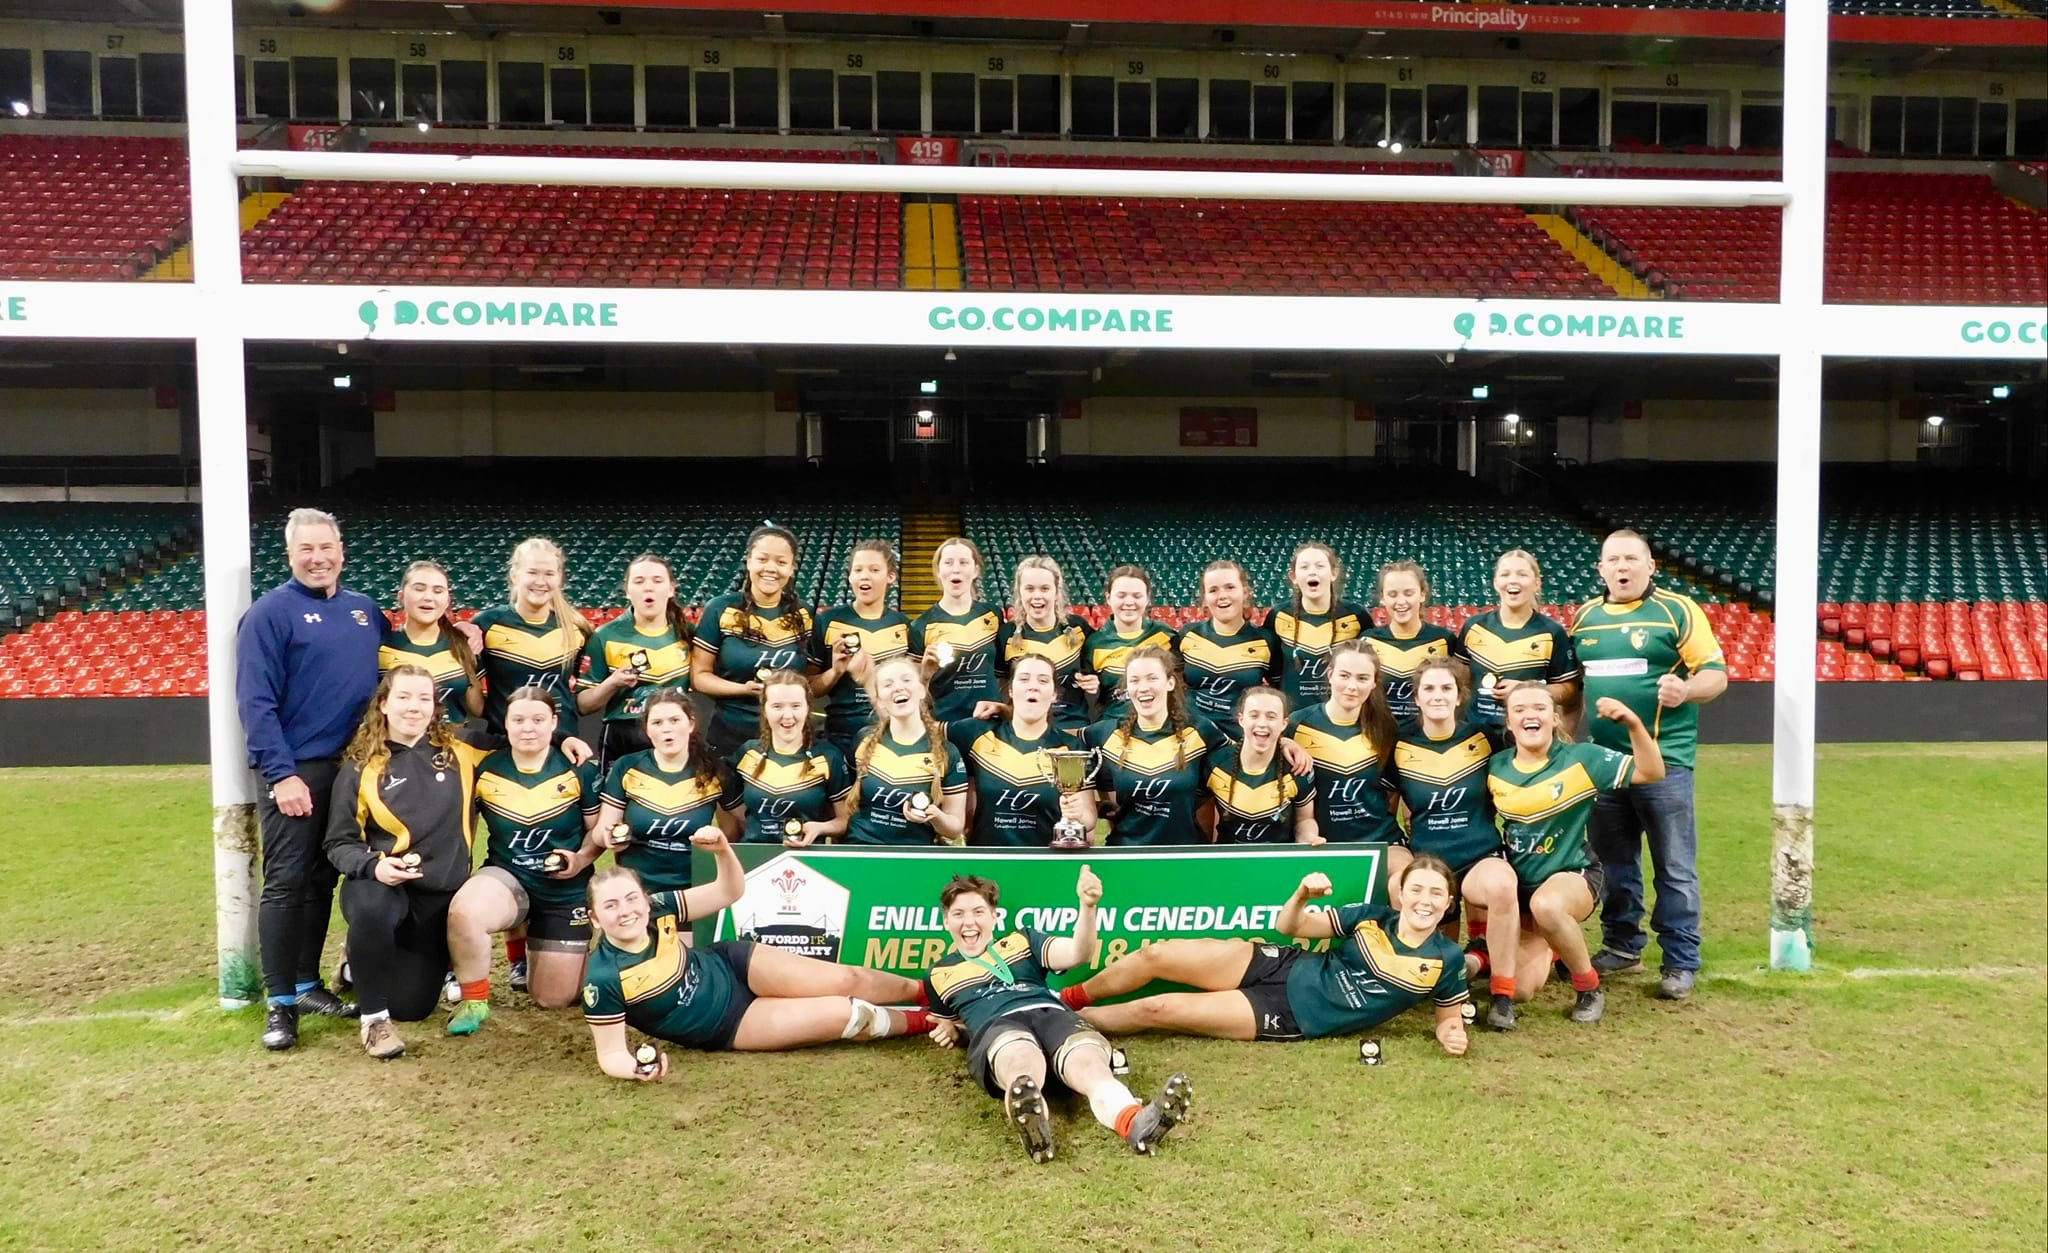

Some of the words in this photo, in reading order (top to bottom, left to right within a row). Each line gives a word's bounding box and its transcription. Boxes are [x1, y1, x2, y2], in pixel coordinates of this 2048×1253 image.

[1432, 7, 1528, 30] Principality
[106, 35, 124, 49] 57
[259, 39, 276, 53] 58
[410, 43, 426, 57] 58
[558, 47, 574, 61] 58
[703, 50, 720, 64] 58
[847, 54, 863, 68] 58
[988, 57, 1004, 71] 58
[1128, 61, 1144, 74] 59
[1264, 65, 1280, 79] 60
[1399, 68, 1413, 81] 61
[1531, 72, 1547, 84] 62
[910, 141, 943, 157] 419
[928, 306, 1173, 332] GO.COMPARE
[1961, 321, 2047, 343] GO.C
[1014, 906, 1117, 932] CWPN
[760, 935, 810, 945] FFORDD
